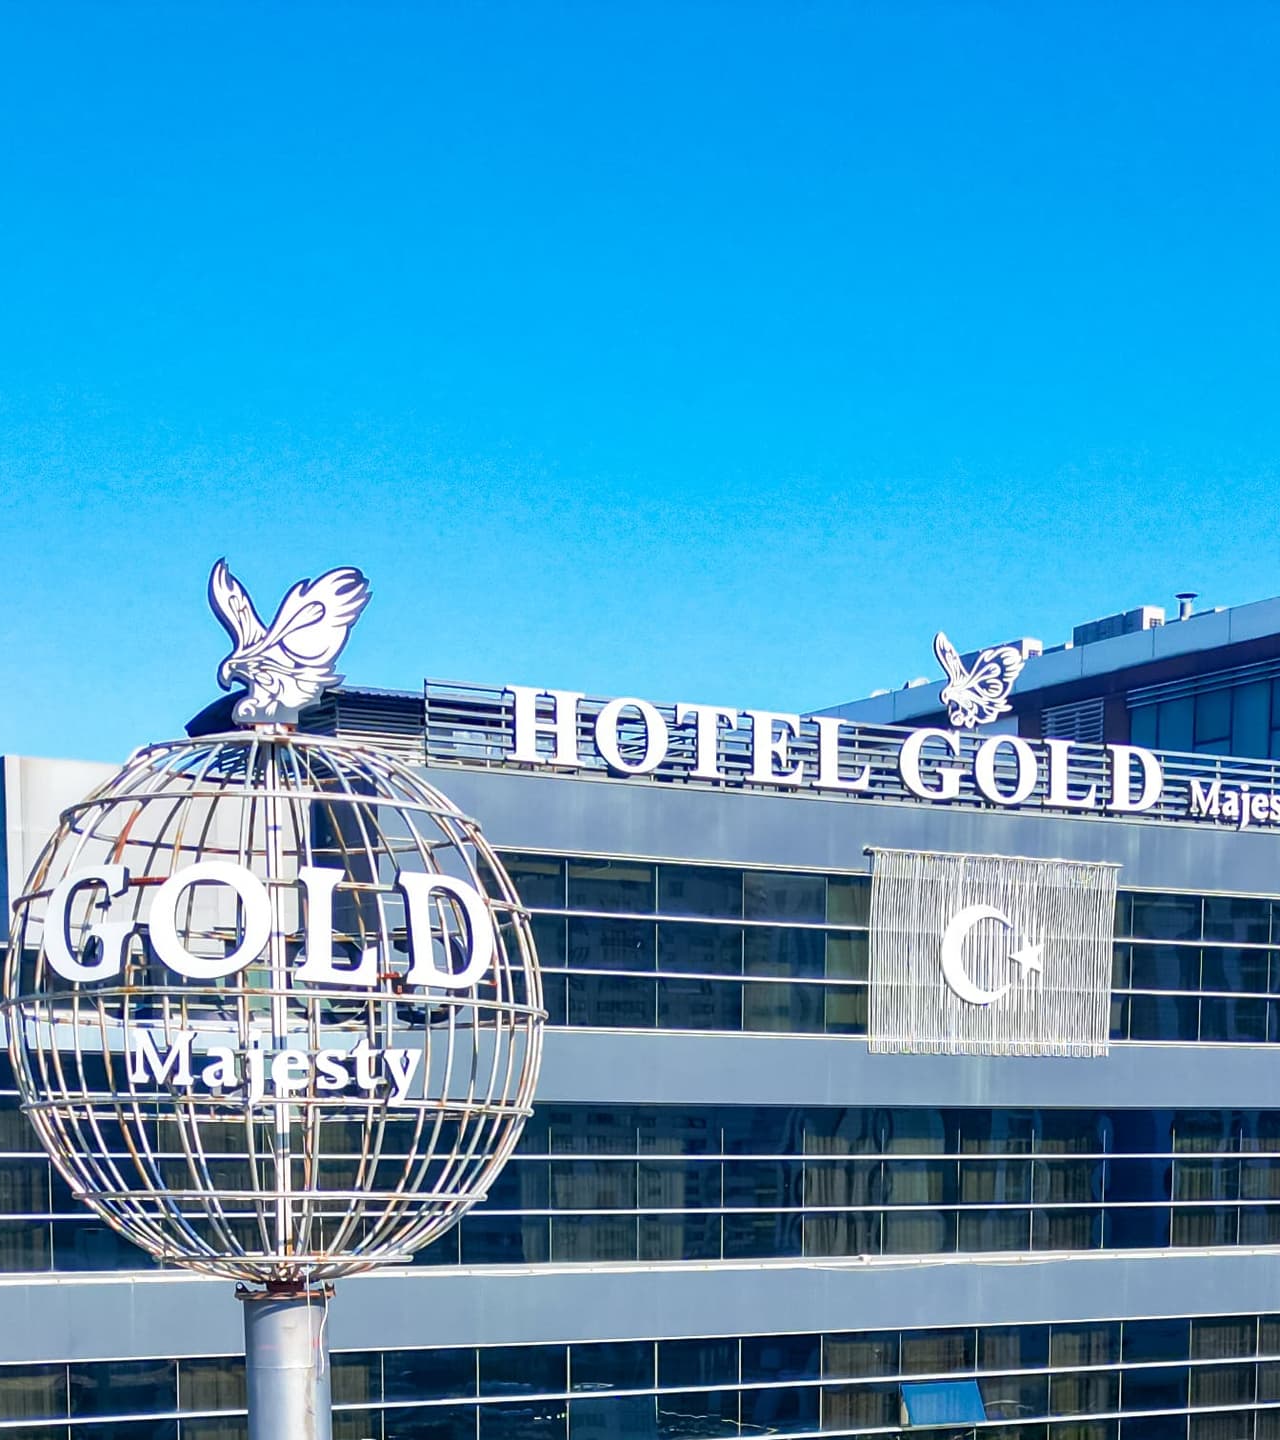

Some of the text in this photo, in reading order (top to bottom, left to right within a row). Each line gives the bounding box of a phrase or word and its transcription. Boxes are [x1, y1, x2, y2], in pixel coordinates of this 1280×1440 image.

[505, 684, 871, 791] HOTEL
[898, 727, 1163, 813] GOLD
[43, 860, 494, 989] GOLD
[130, 1028, 423, 1107] Majesty
